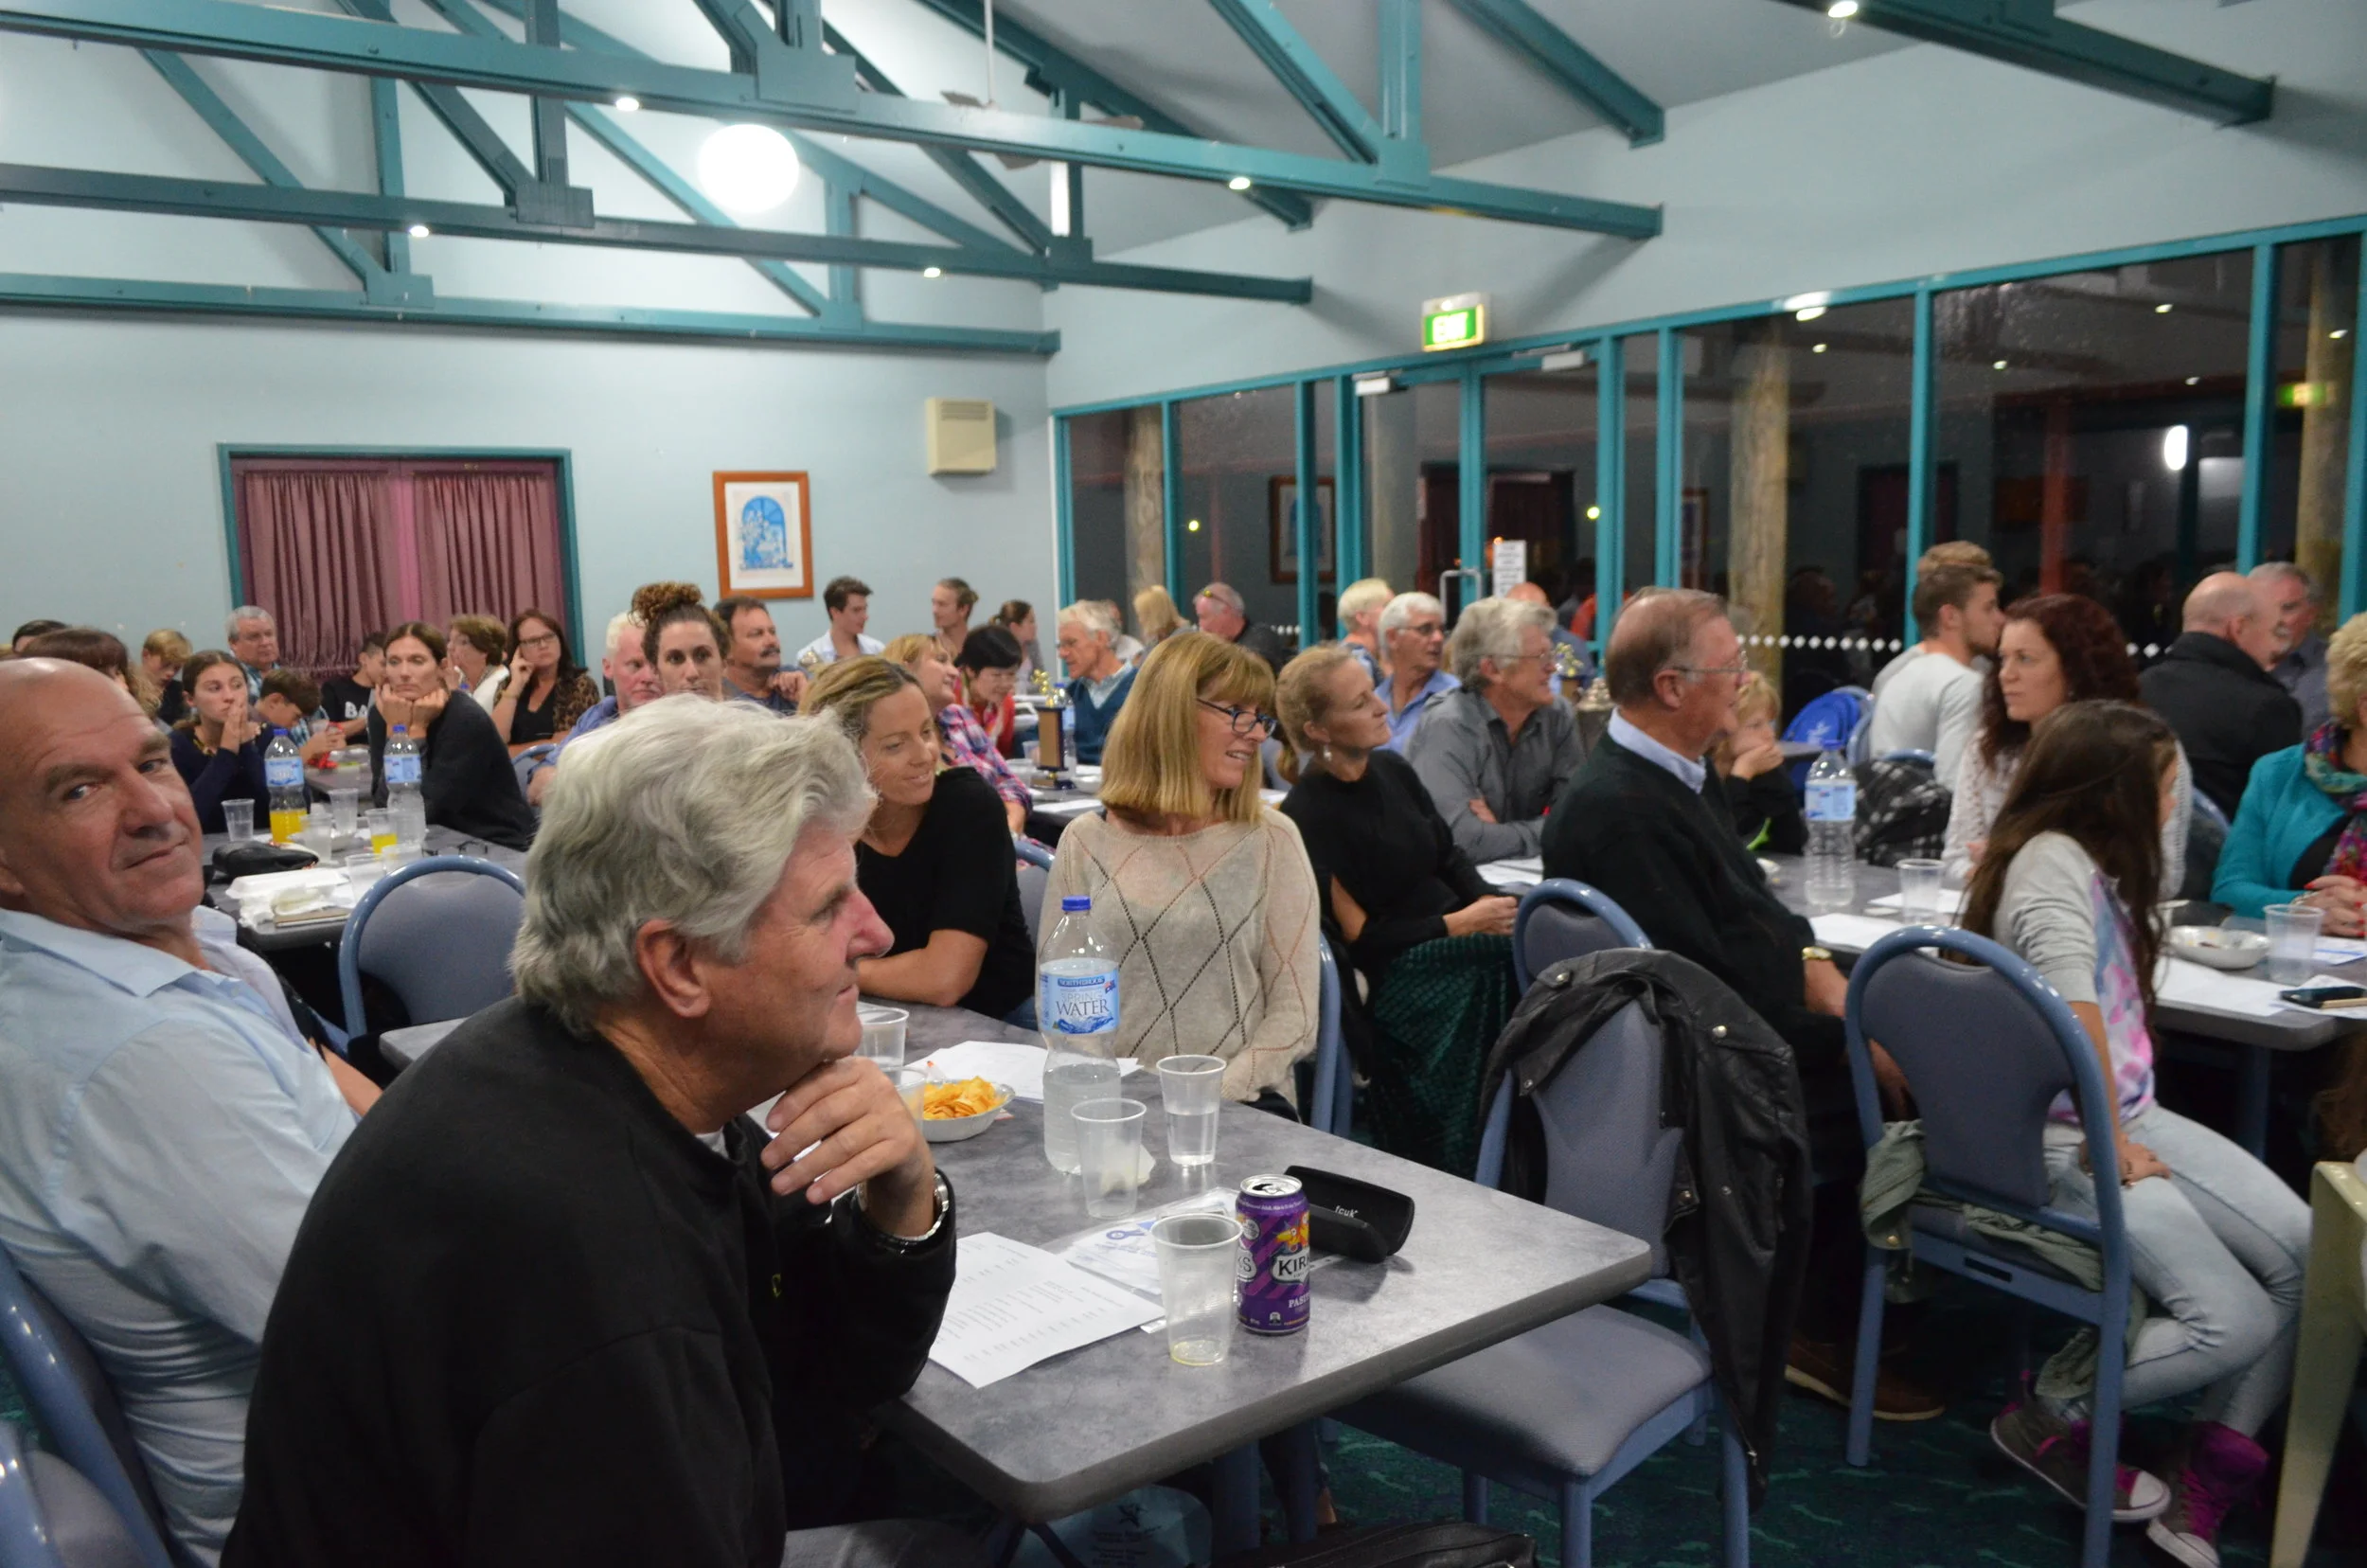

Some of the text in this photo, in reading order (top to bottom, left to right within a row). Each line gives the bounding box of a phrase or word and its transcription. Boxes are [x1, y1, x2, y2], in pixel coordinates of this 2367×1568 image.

[1061, 990, 1103, 1003] SPRING
[1056, 999, 1109, 1016] WATER
[1278, 1256, 1308, 1276] KIR
